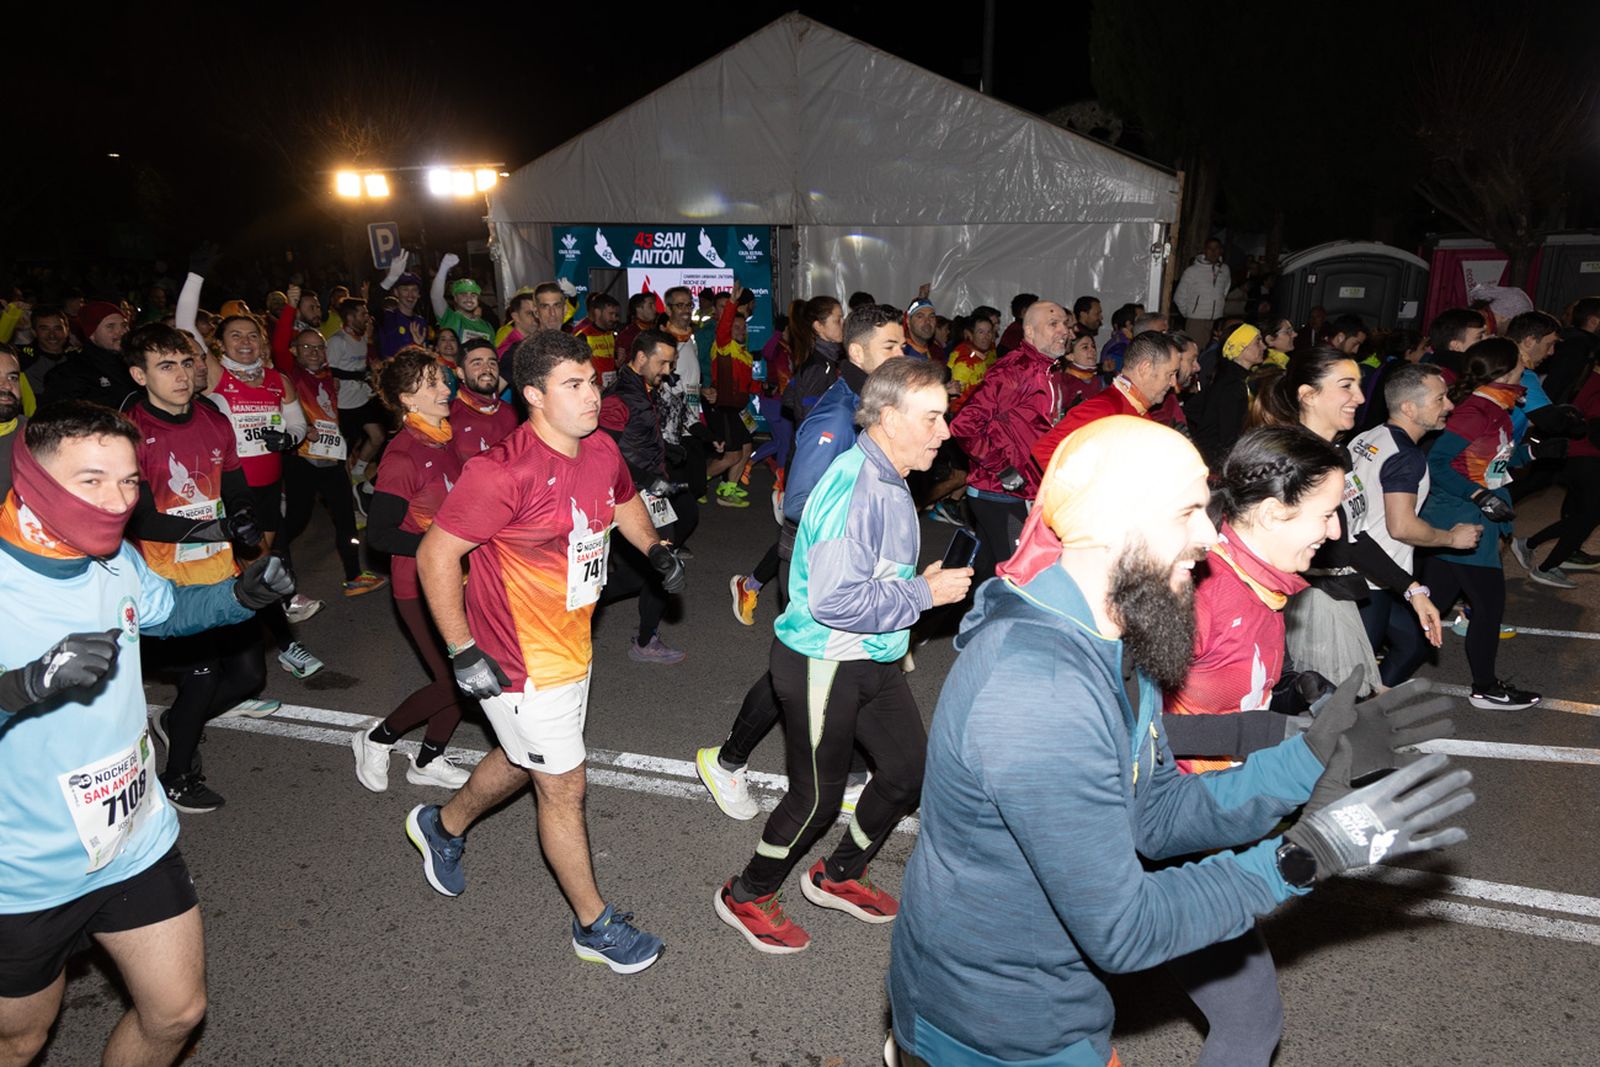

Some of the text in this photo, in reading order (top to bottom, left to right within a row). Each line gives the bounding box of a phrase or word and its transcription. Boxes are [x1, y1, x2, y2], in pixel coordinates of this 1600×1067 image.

[633, 231, 686, 249] 43 SAN
[602, 249, 612, 260] 43
[631, 245, 684, 265] ANTÓN
[706, 250, 716, 262] 43
[319, 433, 341, 447] 1789
[181, 483, 195, 499] 43
[94, 761, 129, 785] NOCHE
[130, 753, 138, 767] DE
[84, 784, 110, 804] SAN
[102, 768, 147, 827] 7108
